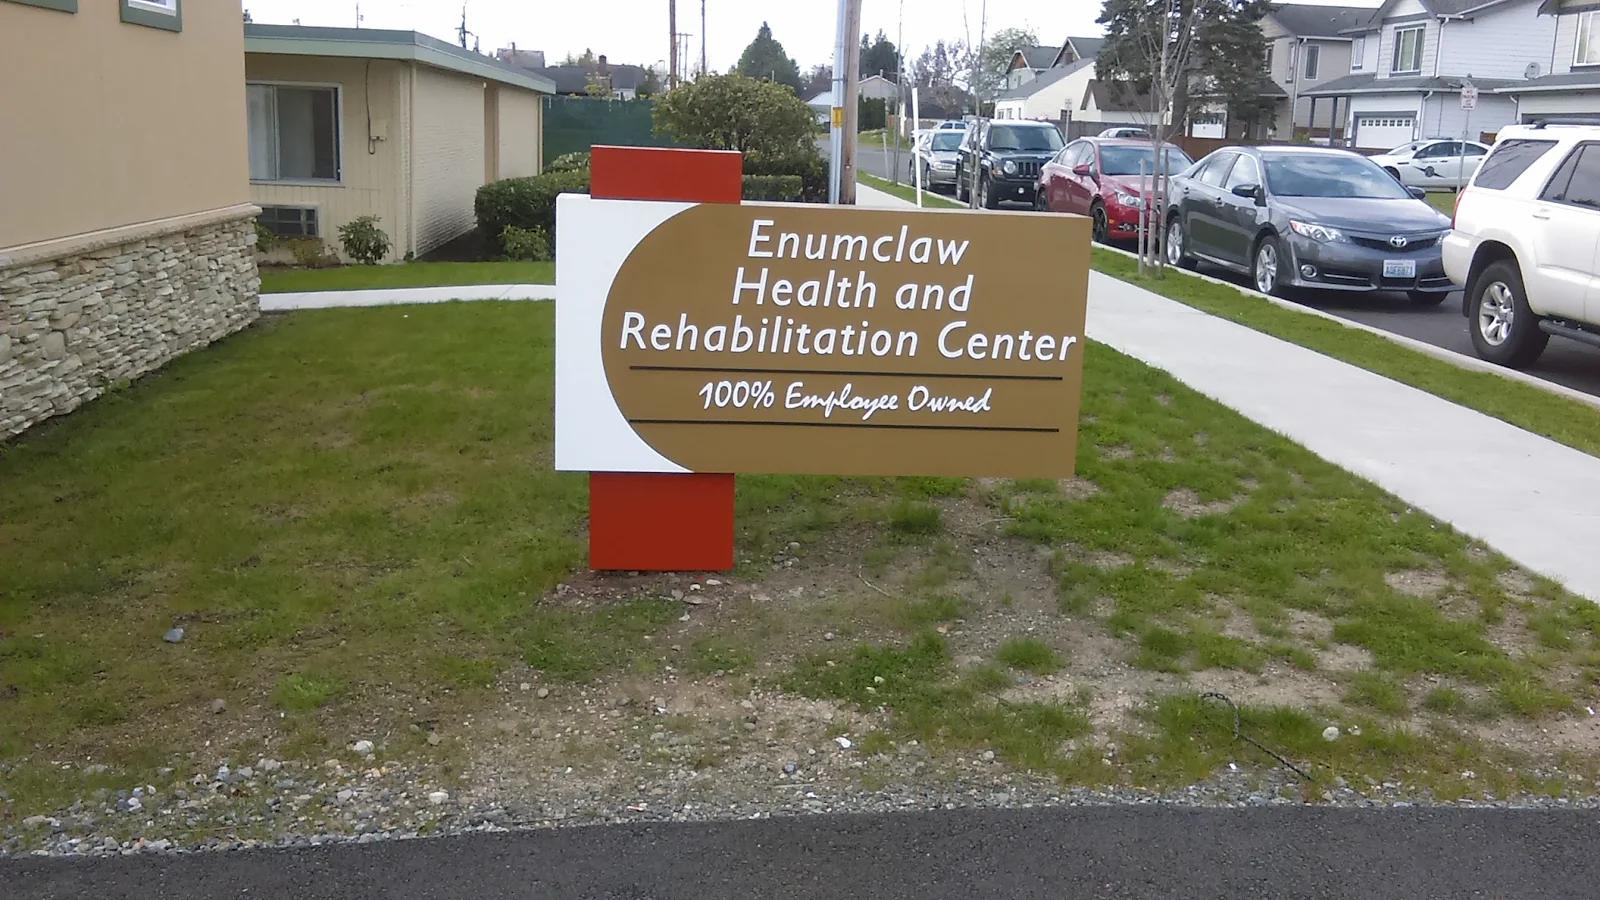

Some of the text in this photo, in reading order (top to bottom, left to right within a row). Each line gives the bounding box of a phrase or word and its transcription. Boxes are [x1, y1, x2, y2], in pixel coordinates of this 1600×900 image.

[747, 218, 970, 266] Enumclaw
[732, 266, 975, 312] Health and
[619, 311, 1077, 362] Rehabilitation Center
[698, 380, 993, 421] 100% Employee Owned
